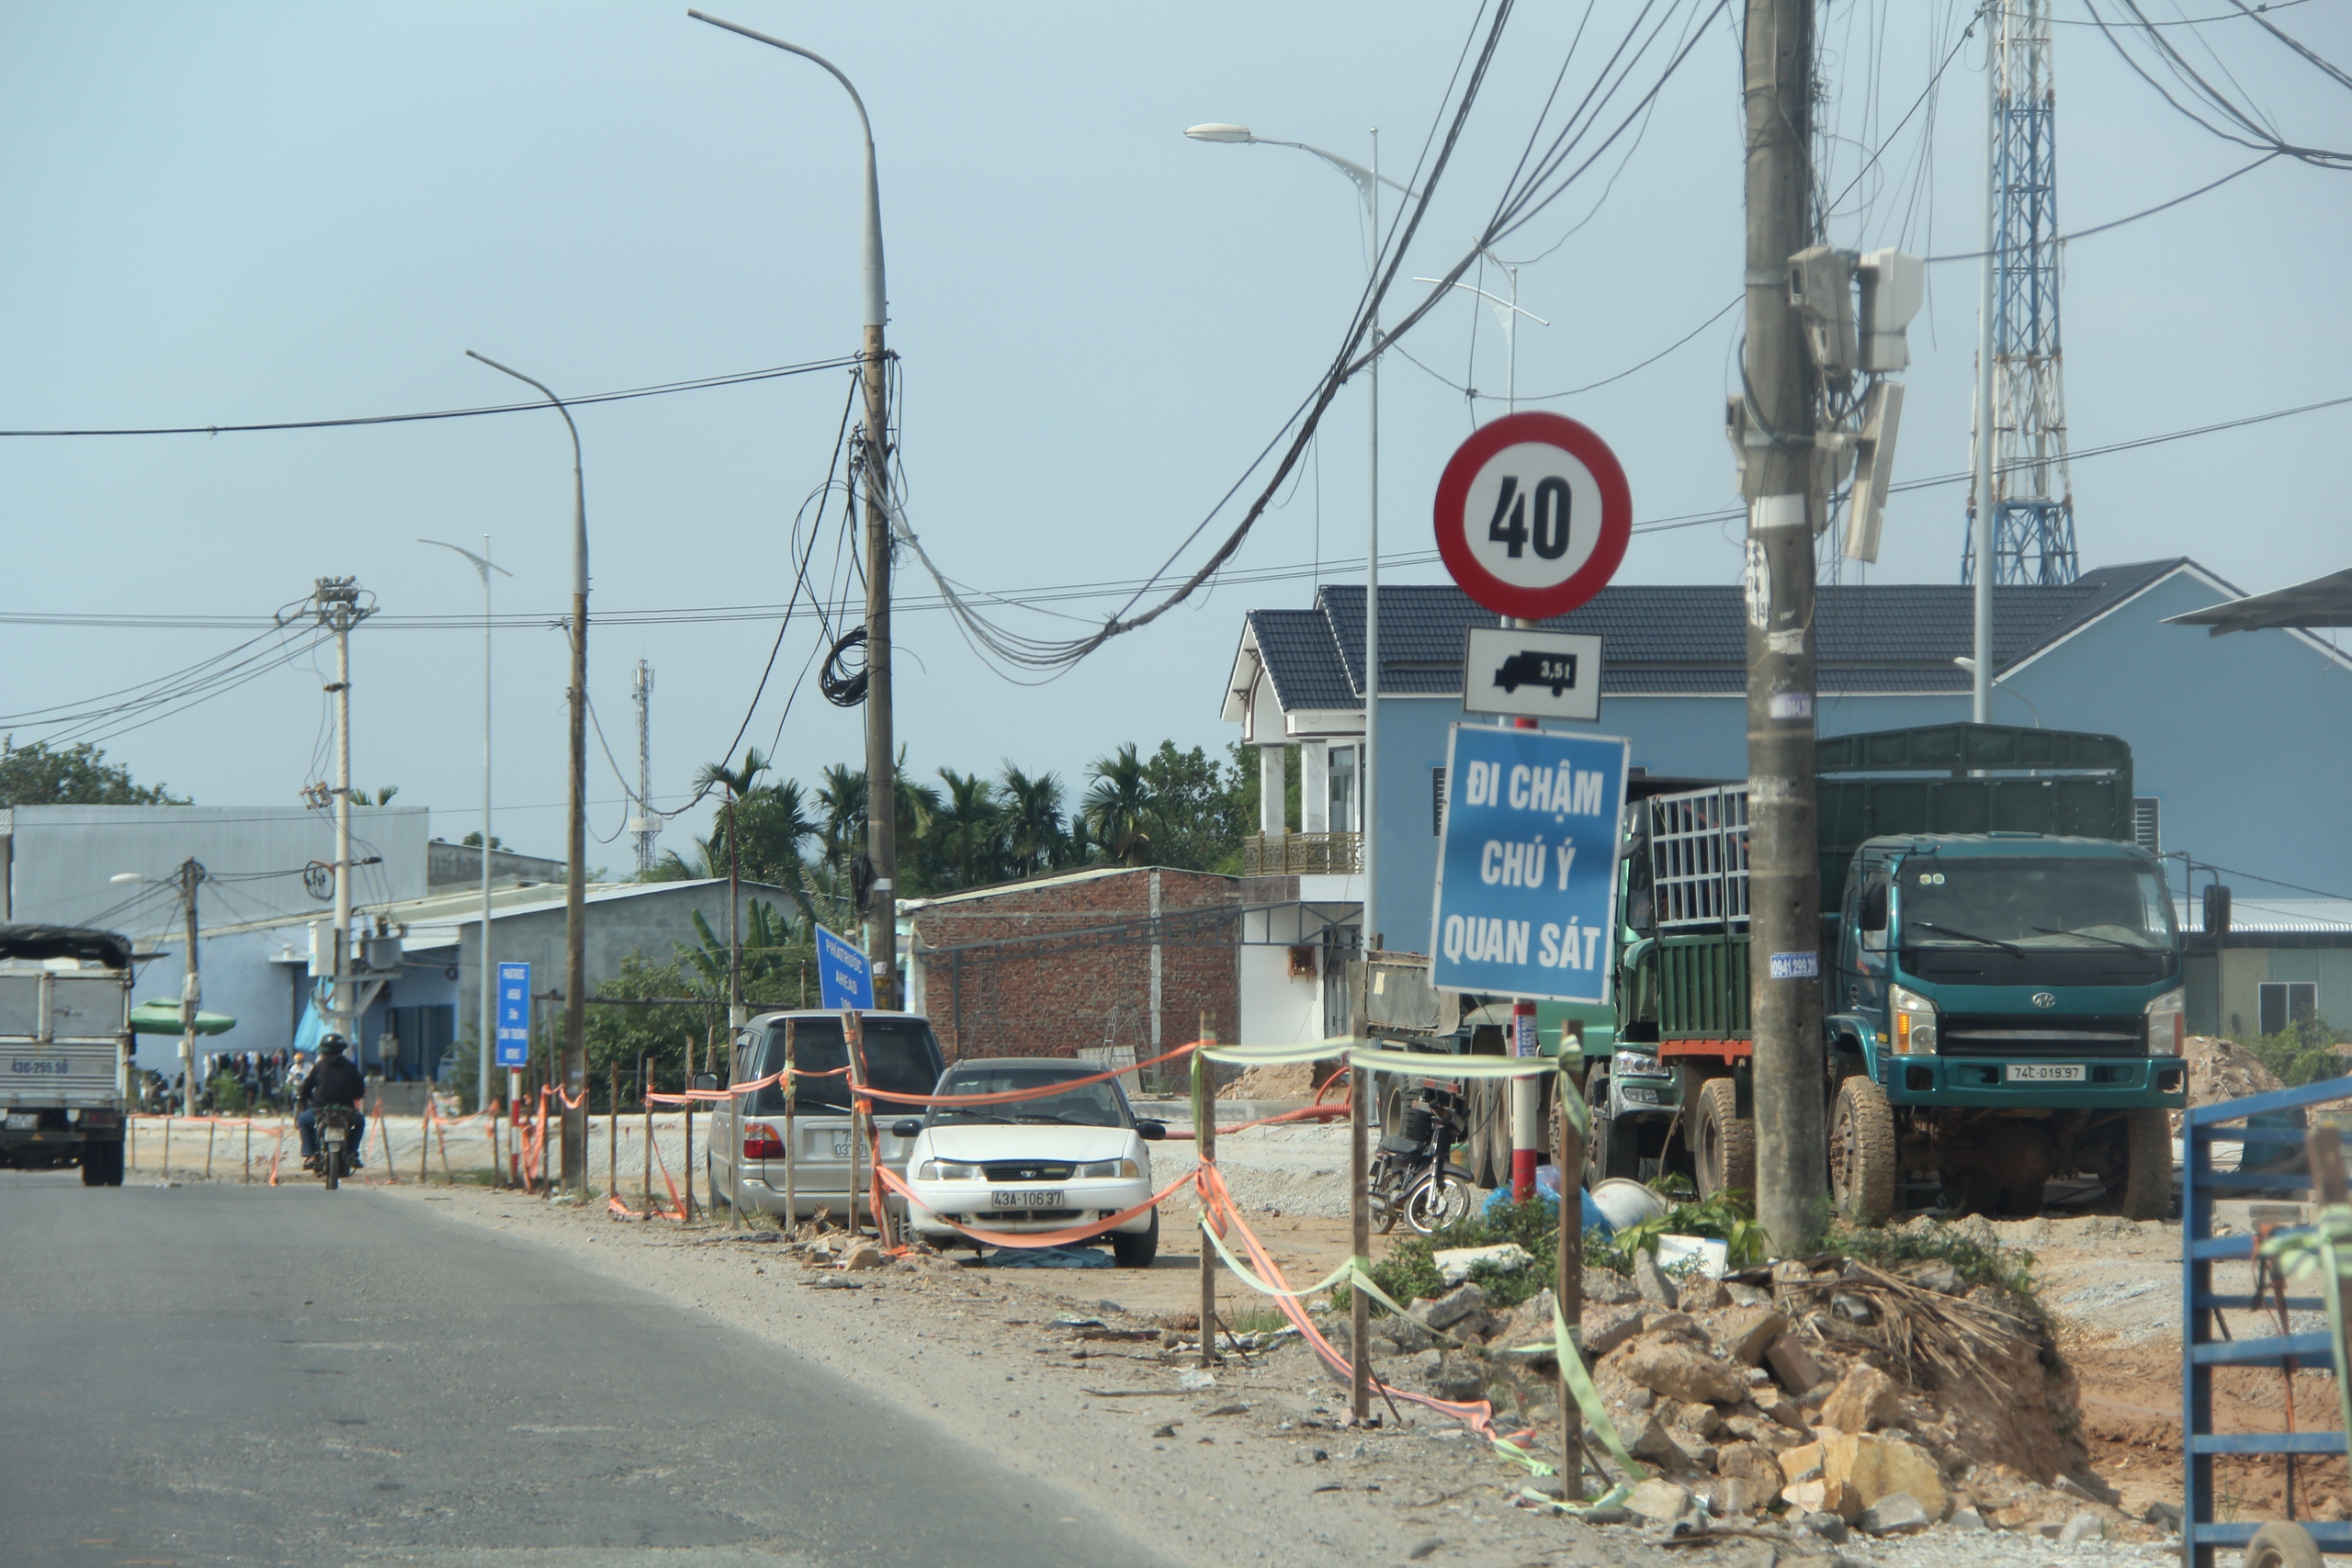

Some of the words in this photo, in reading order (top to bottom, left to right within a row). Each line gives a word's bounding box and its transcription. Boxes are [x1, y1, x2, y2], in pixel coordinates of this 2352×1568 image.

[1489, 475, 1572, 559] 40
[1466, 761, 1500, 807] ĐI
[1509, 759, 1604, 823] CHẬM
[1481, 834, 1546, 888] CHÚ
[1557, 837, 1577, 890] Ý
[1443, 914, 1530, 964] QUAN
[1538, 916, 1601, 971] SÁT
[836, 970, 857, 995] AHEAD
[994, 1191, 1061, 1206] 43A-106.37
